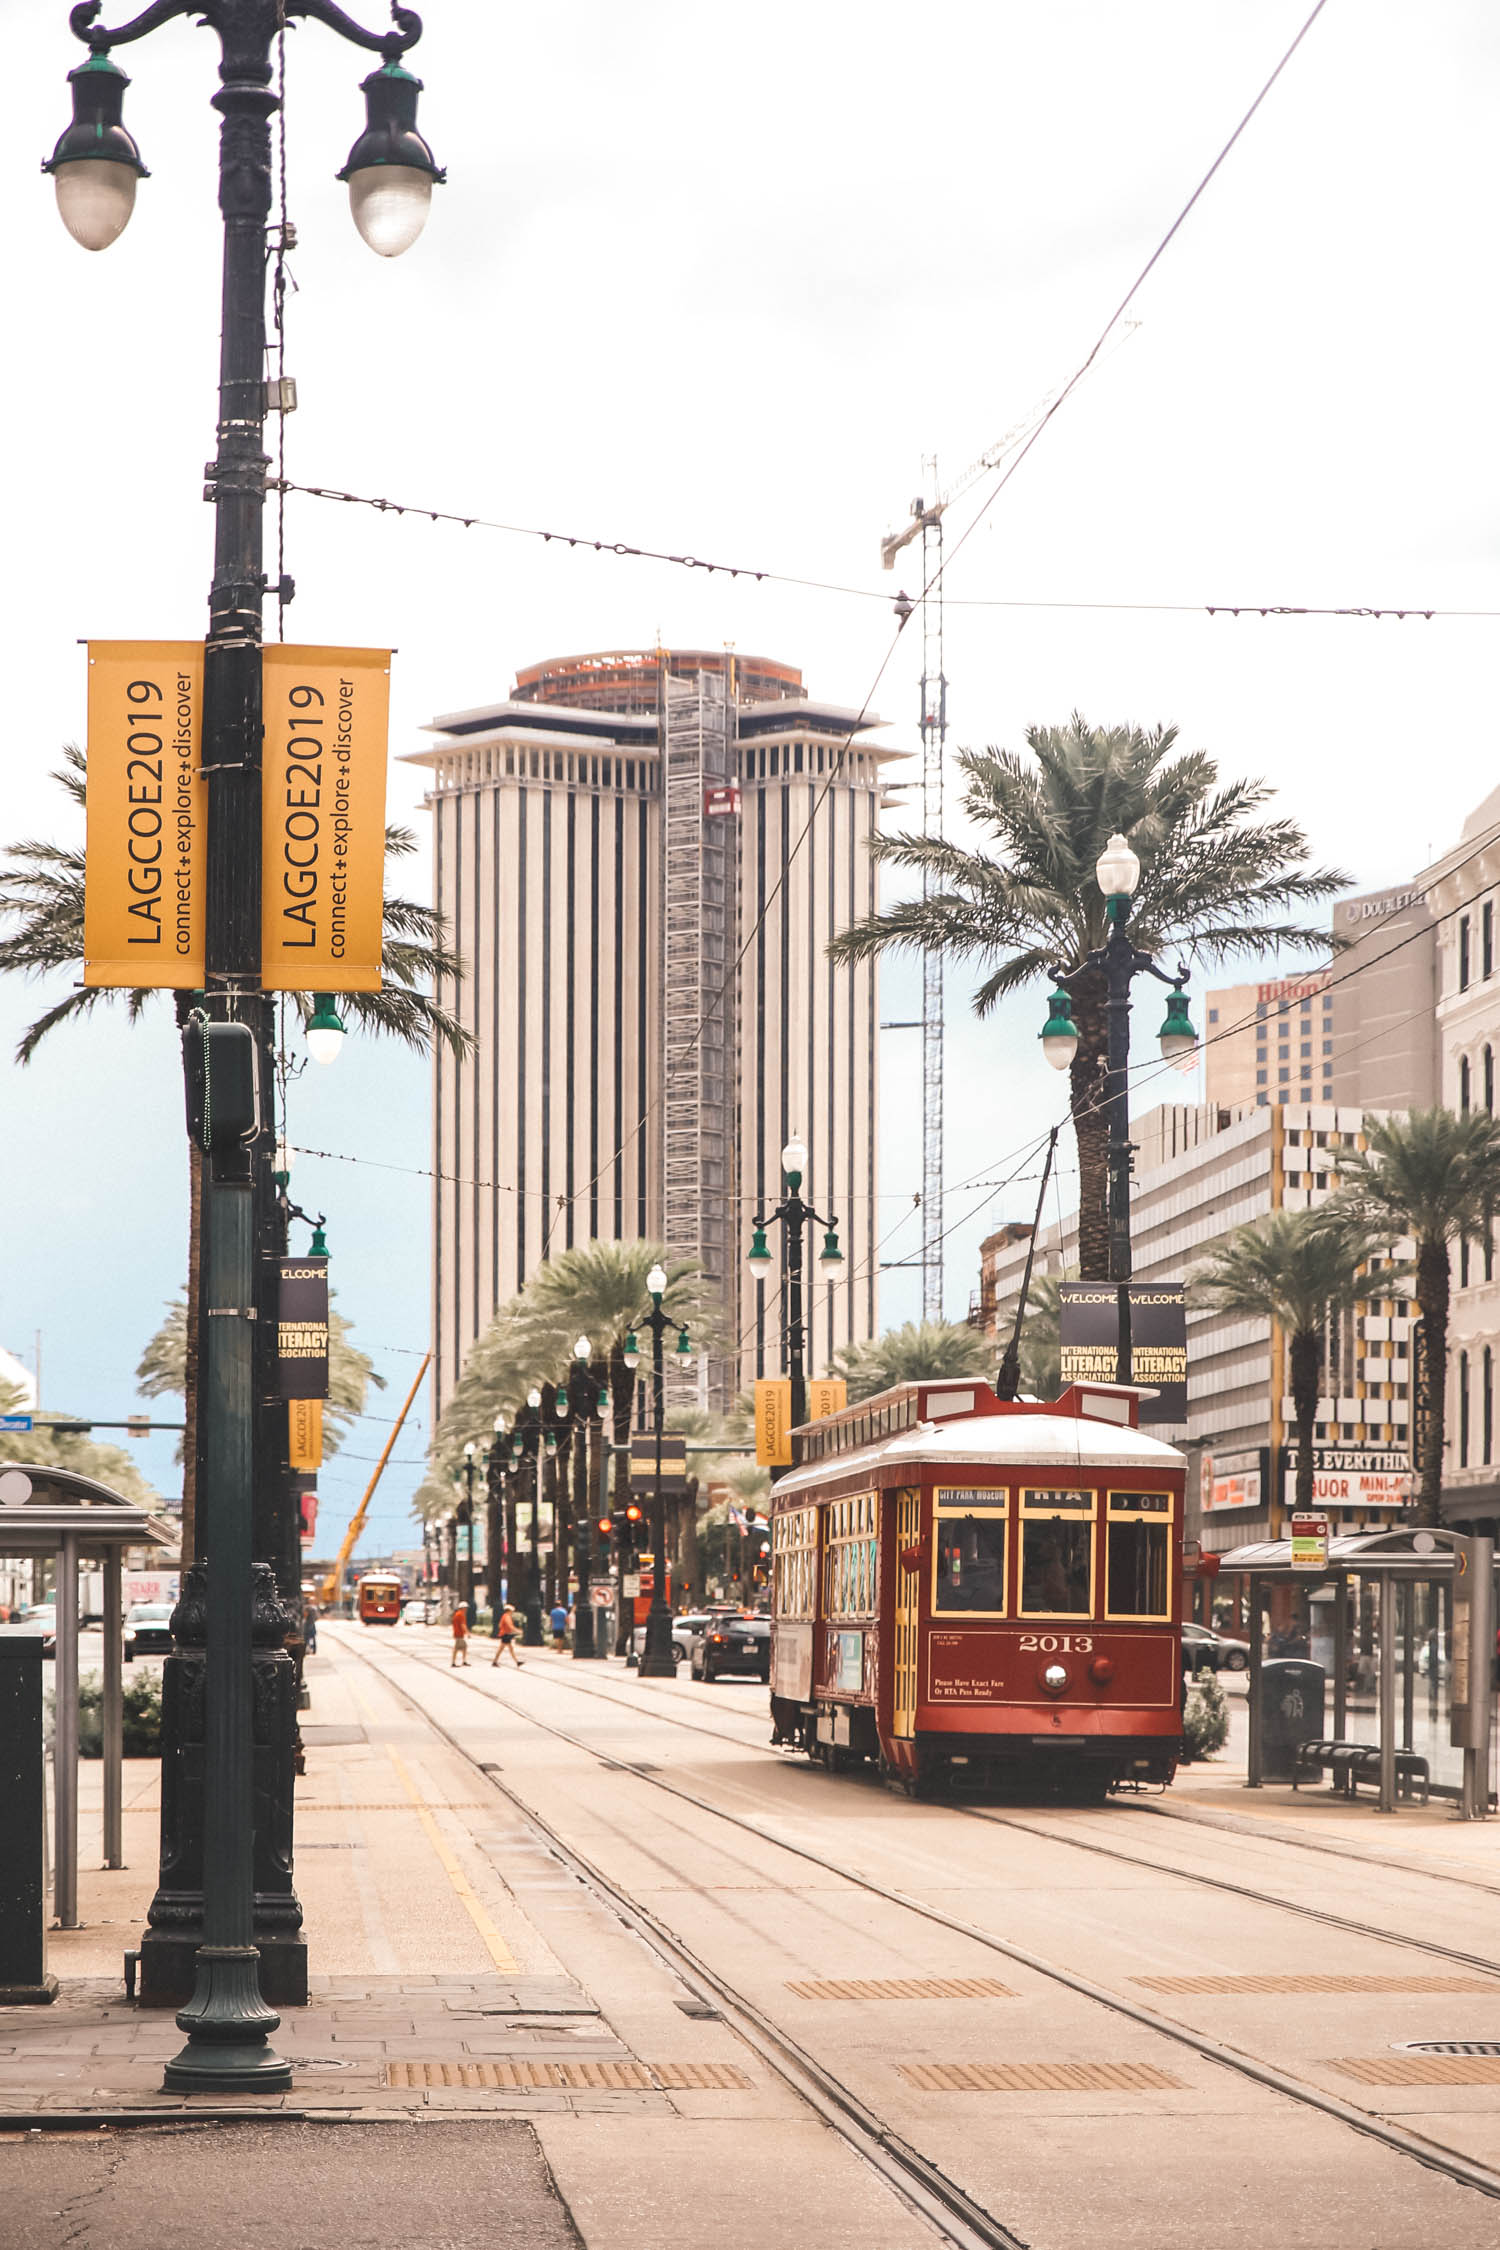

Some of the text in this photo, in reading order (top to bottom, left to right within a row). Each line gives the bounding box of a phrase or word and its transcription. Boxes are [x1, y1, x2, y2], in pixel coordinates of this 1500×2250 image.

[126, 679, 163, 944] LAGCOE2019
[172, 671, 196, 955] connect explore discover
[282, 684, 325, 947] LAGCOE2019
[329, 678, 354, 958] connect explore discover
[1257, 980, 1318, 1002] Hilton
[280, 1269, 328, 1279] ELCOME
[1059, 1293, 1118, 1304] WELCOME
[1128, 1294, 1184, 1304] WELCOME
[279, 1322, 328, 1331] TERNATIONAL
[278, 1332, 328, 1348] ITERACY
[1060, 1345, 1119, 1356] INTERNATIONAL
[1132, 1346, 1186, 1357] INTERNATIONAL
[1060, 1356, 1119, 1372] LITERACY
[1132, 1356, 1187, 1373] LITERACY
[1060, 1372, 1116, 1382] ASSOCIATION
[1133, 1373, 1186, 1383] ASSOCIATION
[765, 1390, 776, 1456] LAGCOE2019
[1323, 1451, 1410, 1470] EVERYTHIN
[1019, 1635, 1093, 1653] 2013
[934, 1678, 953, 1687] Please
[954, 1679, 970, 1687] Have
[971, 1679, 989, 1687] Exact
[944, 1688, 958, 1696] RTA
[959, 1688, 973, 1696] Pass
[974, 1689, 993, 1697] Ready
